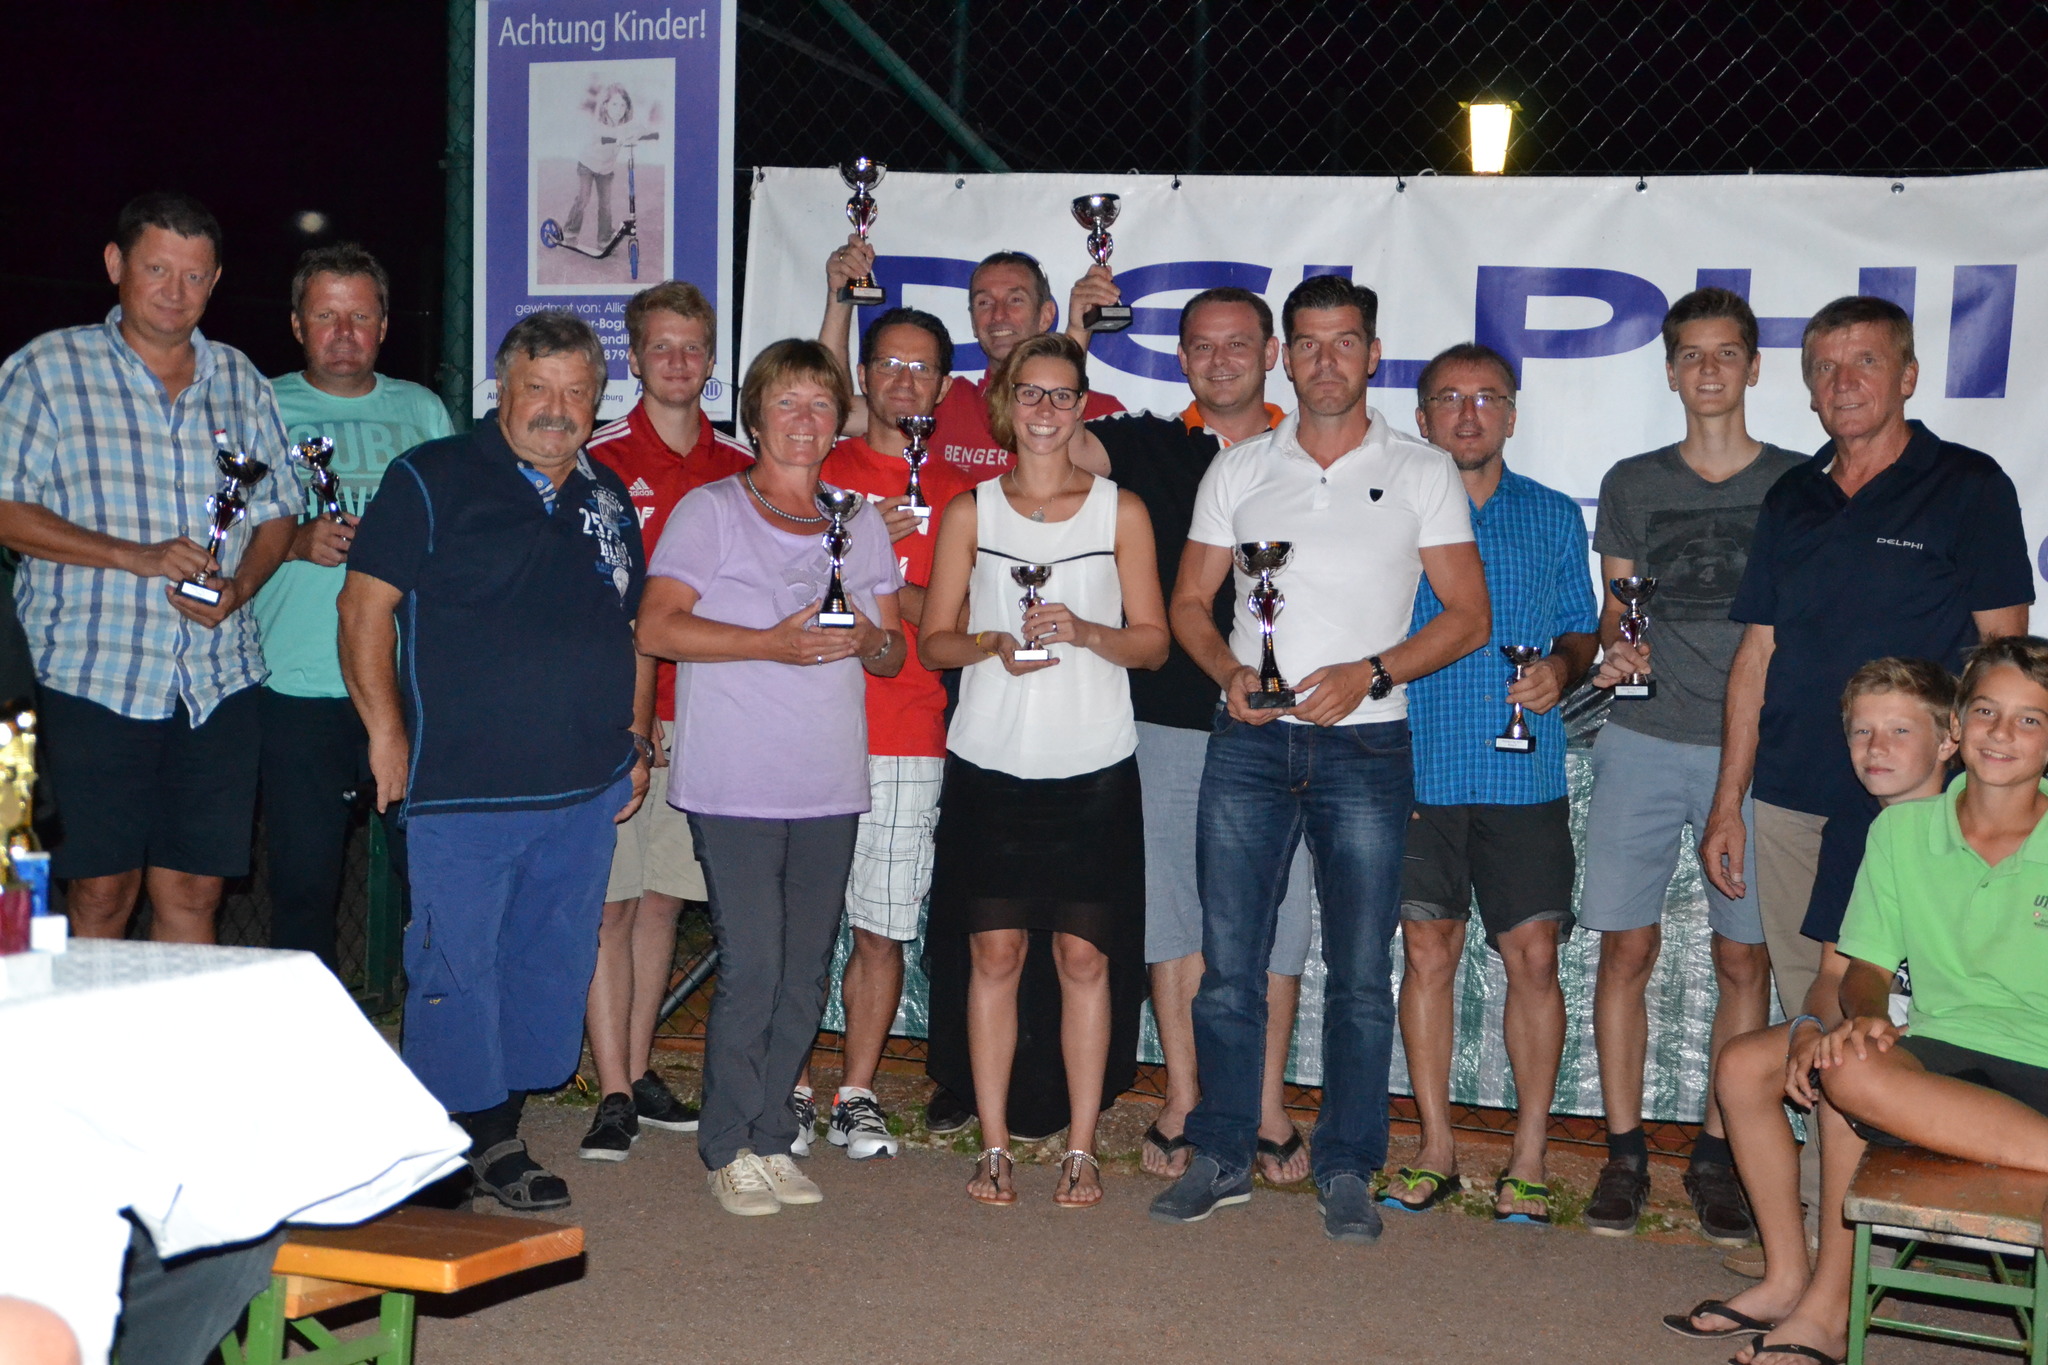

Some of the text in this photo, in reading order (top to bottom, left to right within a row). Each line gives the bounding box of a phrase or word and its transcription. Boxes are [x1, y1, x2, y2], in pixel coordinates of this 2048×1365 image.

[498, 8, 706, 51] Achtung Kinder!
[576, 304, 601, 313] von:
[944, 444, 1008, 466] BENGER
[1876, 537, 1924, 550] DELPHI
